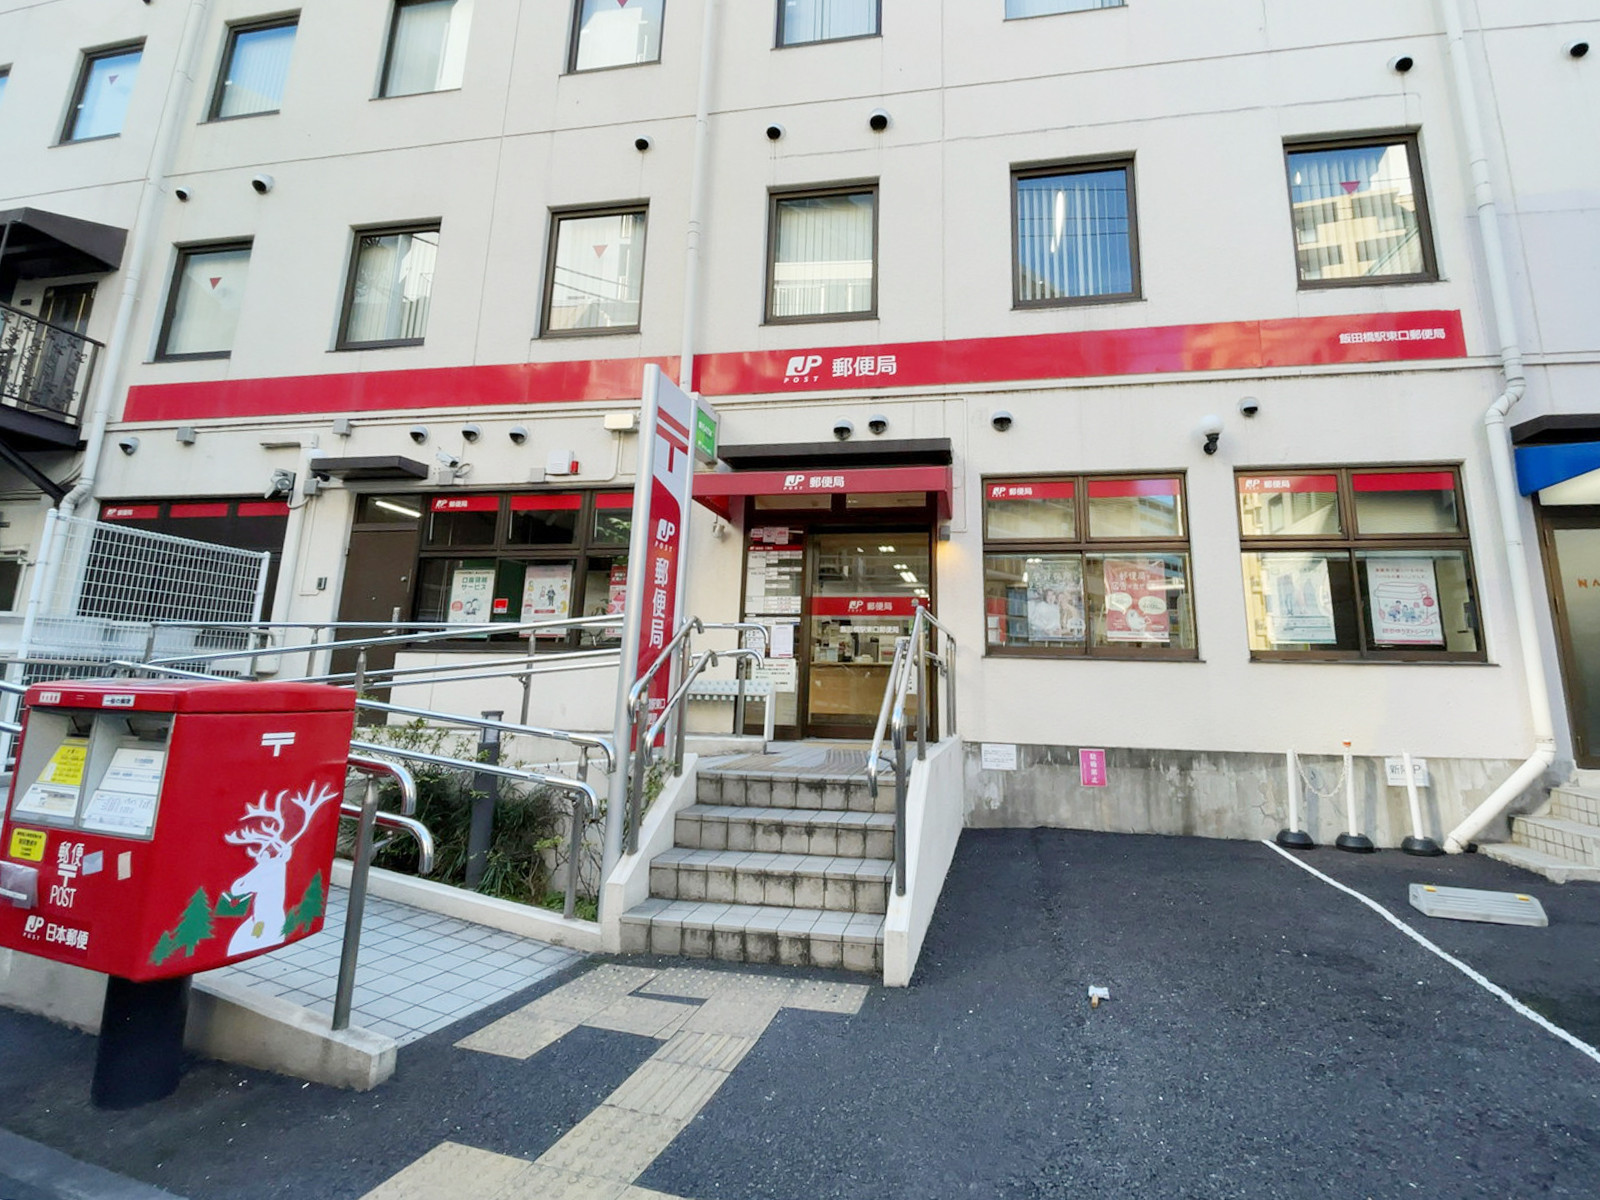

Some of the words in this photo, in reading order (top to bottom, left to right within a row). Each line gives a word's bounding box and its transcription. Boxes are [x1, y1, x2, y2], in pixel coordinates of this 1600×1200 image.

[1339, 328, 1446, 344] 飯田橋駅東口郵便局
[785, 355, 823, 377] JP
[831, 355, 897, 378] 郵便局
[783, 375, 819, 383] POST
[784, 474, 805, 487] JP
[809, 476, 845, 488] 郵便局
[1263, 479, 1291, 489] 郵便局
[1008, 487, 1033, 496] 郵便局
[656, 518, 676, 543] JP
[653, 540, 674, 553] POST
[649, 557, 670, 650] 郵便局
[867, 601, 893, 611] 郵便局
[57, 841, 85, 867] 郵便
[49, 885, 77, 908] POST
[24, 915, 45, 933] JP
[45, 922, 89, 950] 日本郵便
